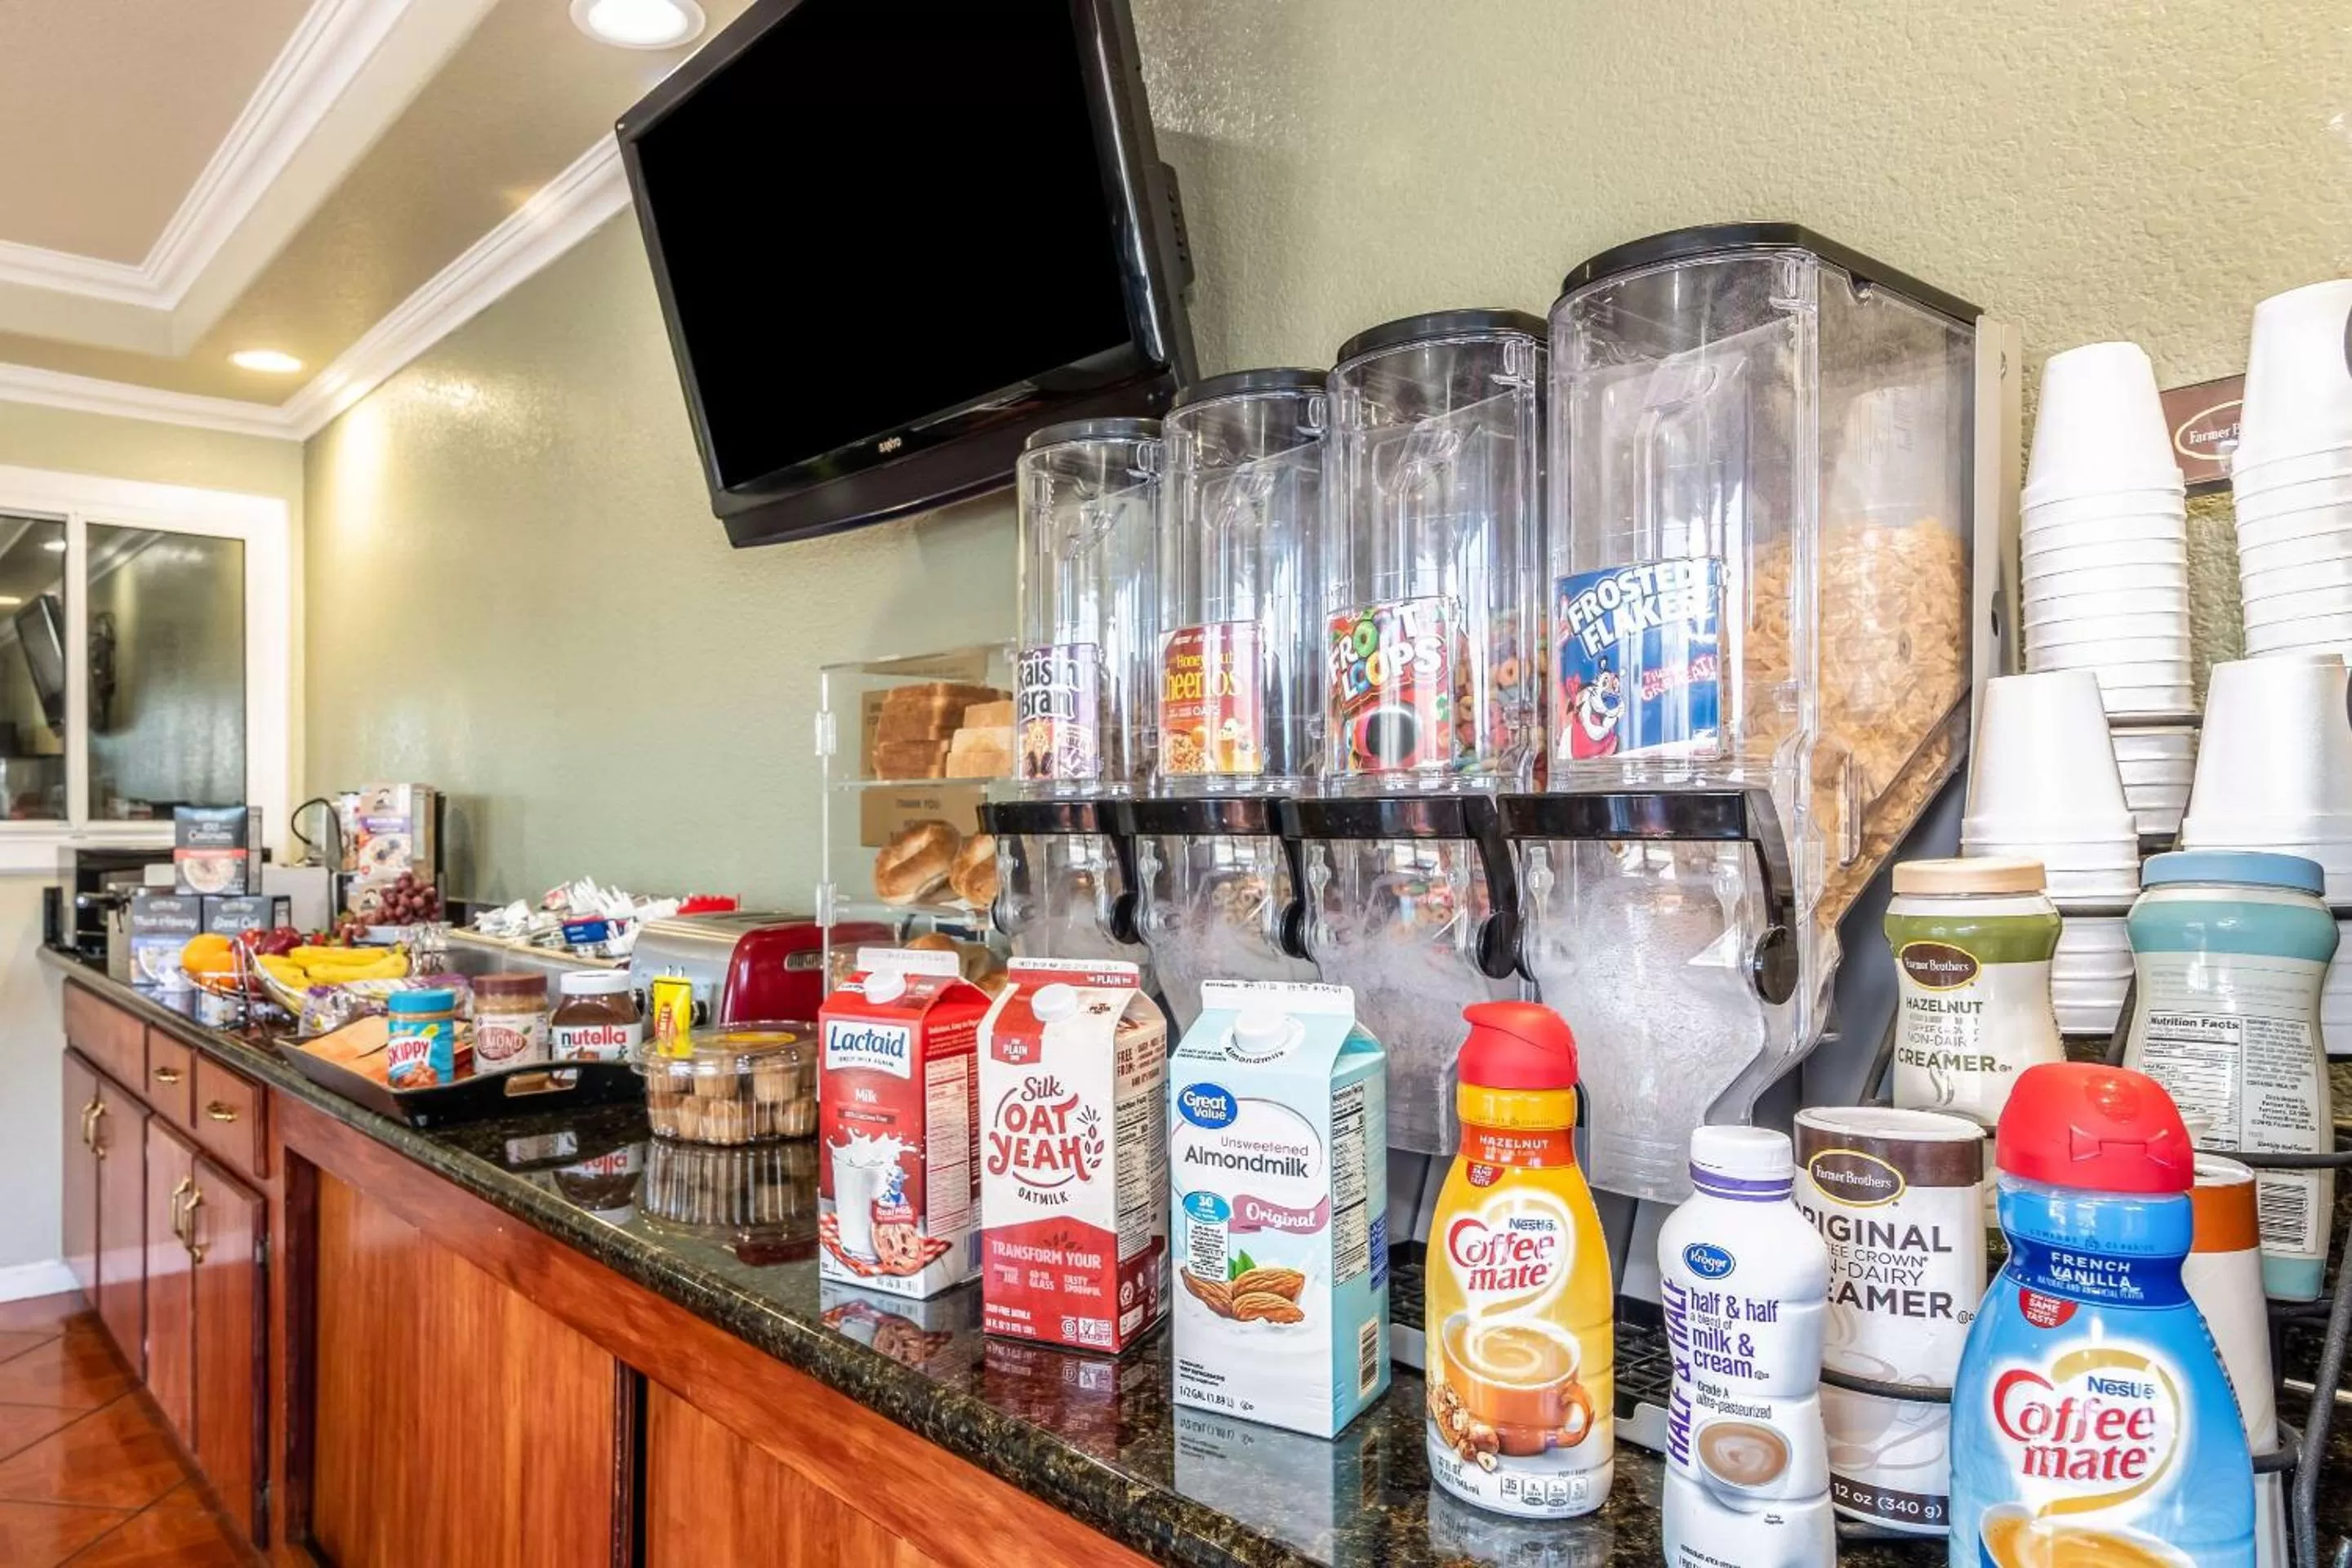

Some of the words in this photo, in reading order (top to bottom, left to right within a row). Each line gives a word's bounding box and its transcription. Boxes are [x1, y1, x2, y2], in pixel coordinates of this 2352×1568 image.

[2189, 427, 2231, 445] Farmer
[1905, 957, 1928, 970] Farmer
[1929, 958, 1970, 972] Brothers
[1097, 975, 1120, 985] PLAIN
[1906, 996, 1984, 1014] HAZELNUT
[2149, 1015, 2198, 1027] Nutrition
[2202, 1018, 2240, 1030] Facts
[561, 1025, 627, 1046] nutella
[830, 1025, 906, 1058] Lactaid
[1003, 1045, 1027, 1056] PLAIN
[1117, 1048, 1133, 1063] FREE
[1898, 1046, 1998, 1072] CREAMER
[855, 1087, 878, 1103] Milk
[1021, 1075, 1064, 1102] Silk
[1184, 1090, 1227, 1111] Great
[1004, 1092, 1079, 1134] OAT
[1193, 1102, 1227, 1121] Value
[1220, 1136, 1309, 1157] Unsweetened
[1479, 1134, 1549, 1150] HAZELNUT
[987, 1129, 1091, 1182] YEAH
[1184, 1145, 1310, 1178] Almondmilk
[1815, 1164, 1845, 1182] Farmer
[1846, 1171, 1892, 1189] Brothers
[1018, 1187, 1069, 1205] OATMILK
[1198, 1195, 1214, 1209] 30
[1245, 1202, 1317, 1228] Original
[1795, 1200, 1953, 1254] IGINAL
[992, 1241, 1062, 1266] TRANSFORM
[1066, 1251, 1102, 1269] YOUR
[1449, 1217, 1555, 1268] Coffee
[1690, 1248, 1727, 1272] Kroger
[1855, 1249, 1923, 1268] CROWN
[2051, 1251, 2131, 1273] FRENCH
[1029, 1276, 1055, 1291] GLASS
[1468, 1263, 1550, 1291] mate
[1832, 1258, 1925, 1288] N-DAIRY
[2050, 1264, 2132, 1289] VANILLA
[1690, 1287, 1721, 1316] half
[1726, 1295, 1740, 1320] &
[1745, 1298, 1779, 1323] half
[1829, 1278, 1953, 1319] AMER
[1663, 1277, 1689, 1352] HALF
[1698, 1313, 1722, 1329] blend
[2026, 1310, 2056, 1326] TASTE
[1693, 1327, 1731, 1355] milk
[1738, 1333, 1755, 1358] &
[1694, 1349, 1753, 1379] cream
[1696, 1393, 1771, 1419] ultra-pasteurized
[1993, 1369, 2155, 1443] Coffee
[1667, 1386, 1691, 1466] HALF
[2021, 1446, 2147, 1481] mate
[1505, 1477, 1517, 1490] 35
[1834, 1482, 1849, 1499] 12
[1852, 1490, 1873, 1506] oz
[1878, 1496, 1920, 1515] (340
[1924, 1503, 1943, 1520] g)
